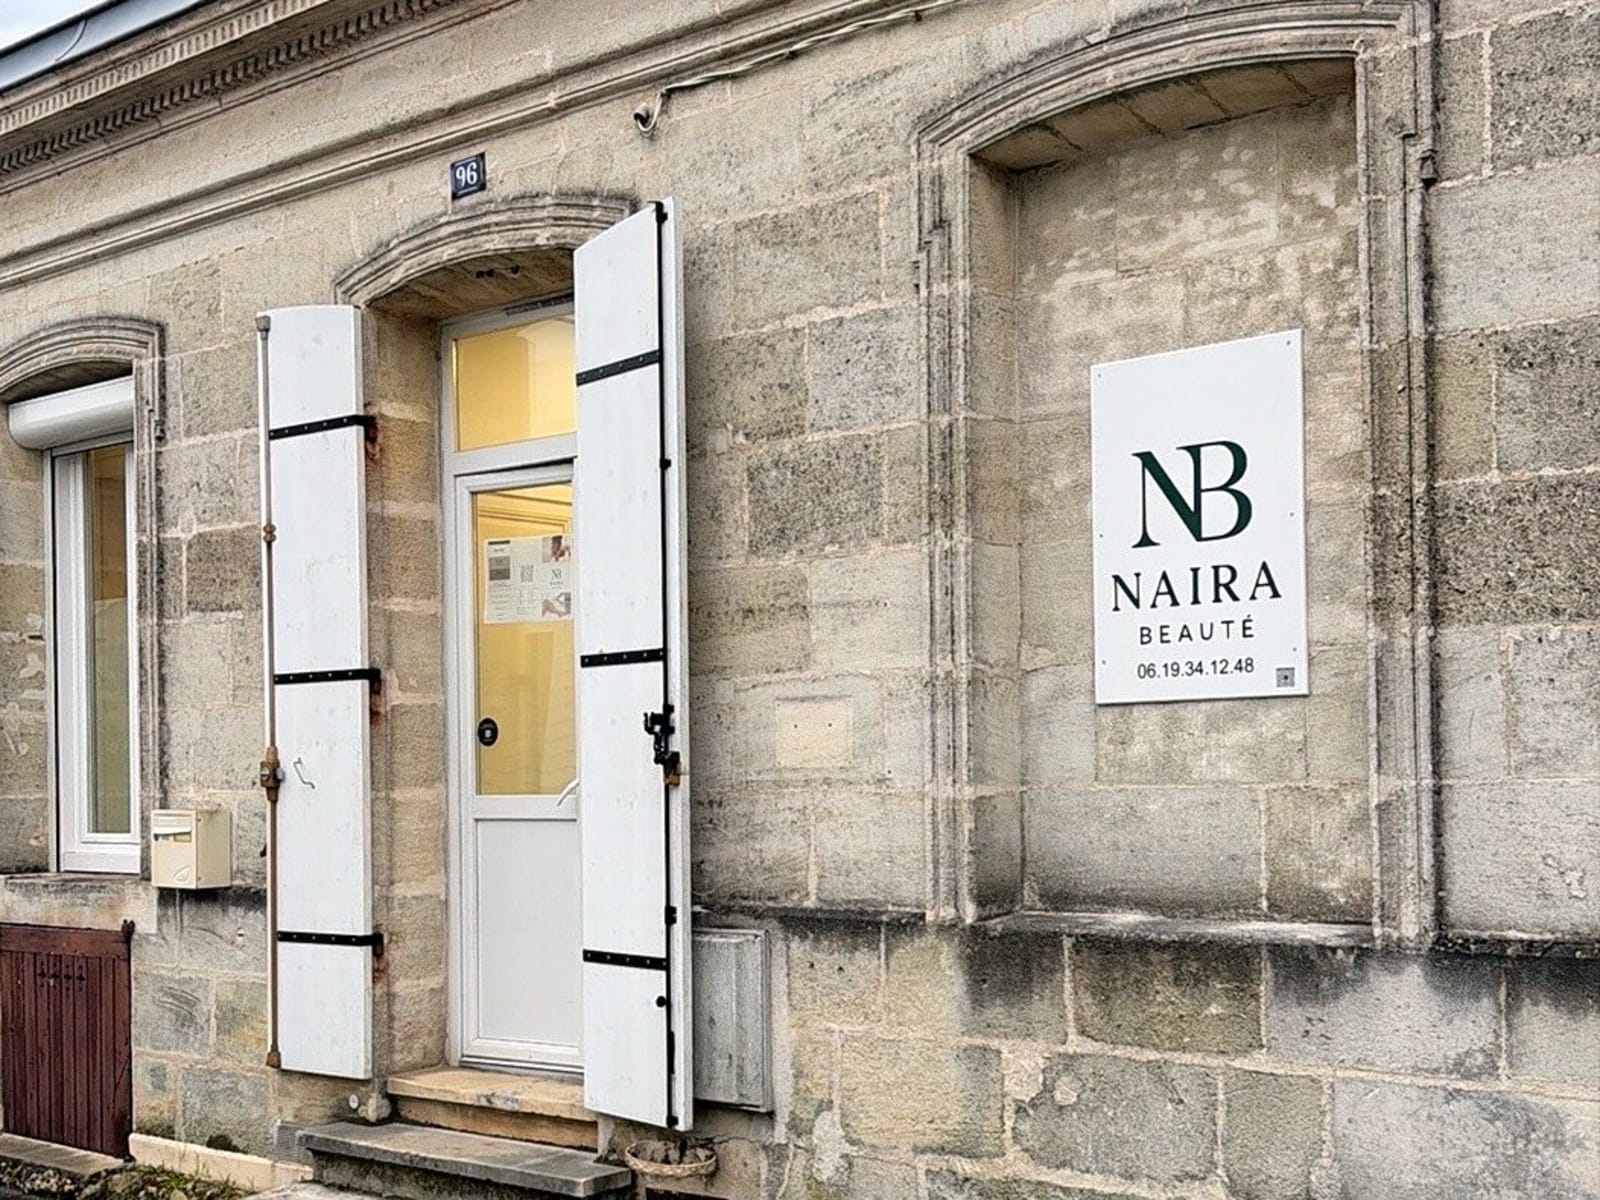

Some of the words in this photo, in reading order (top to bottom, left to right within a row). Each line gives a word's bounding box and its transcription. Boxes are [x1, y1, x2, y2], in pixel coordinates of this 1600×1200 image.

[455, 161, 478, 187] 96
[1131, 440, 1253, 549] NB
[1111, 560, 1282, 612] NAIRA
[1139, 614, 1256, 646] BEAUTÉ
[1136, 657, 1255, 680] 06.19.34.12.48
